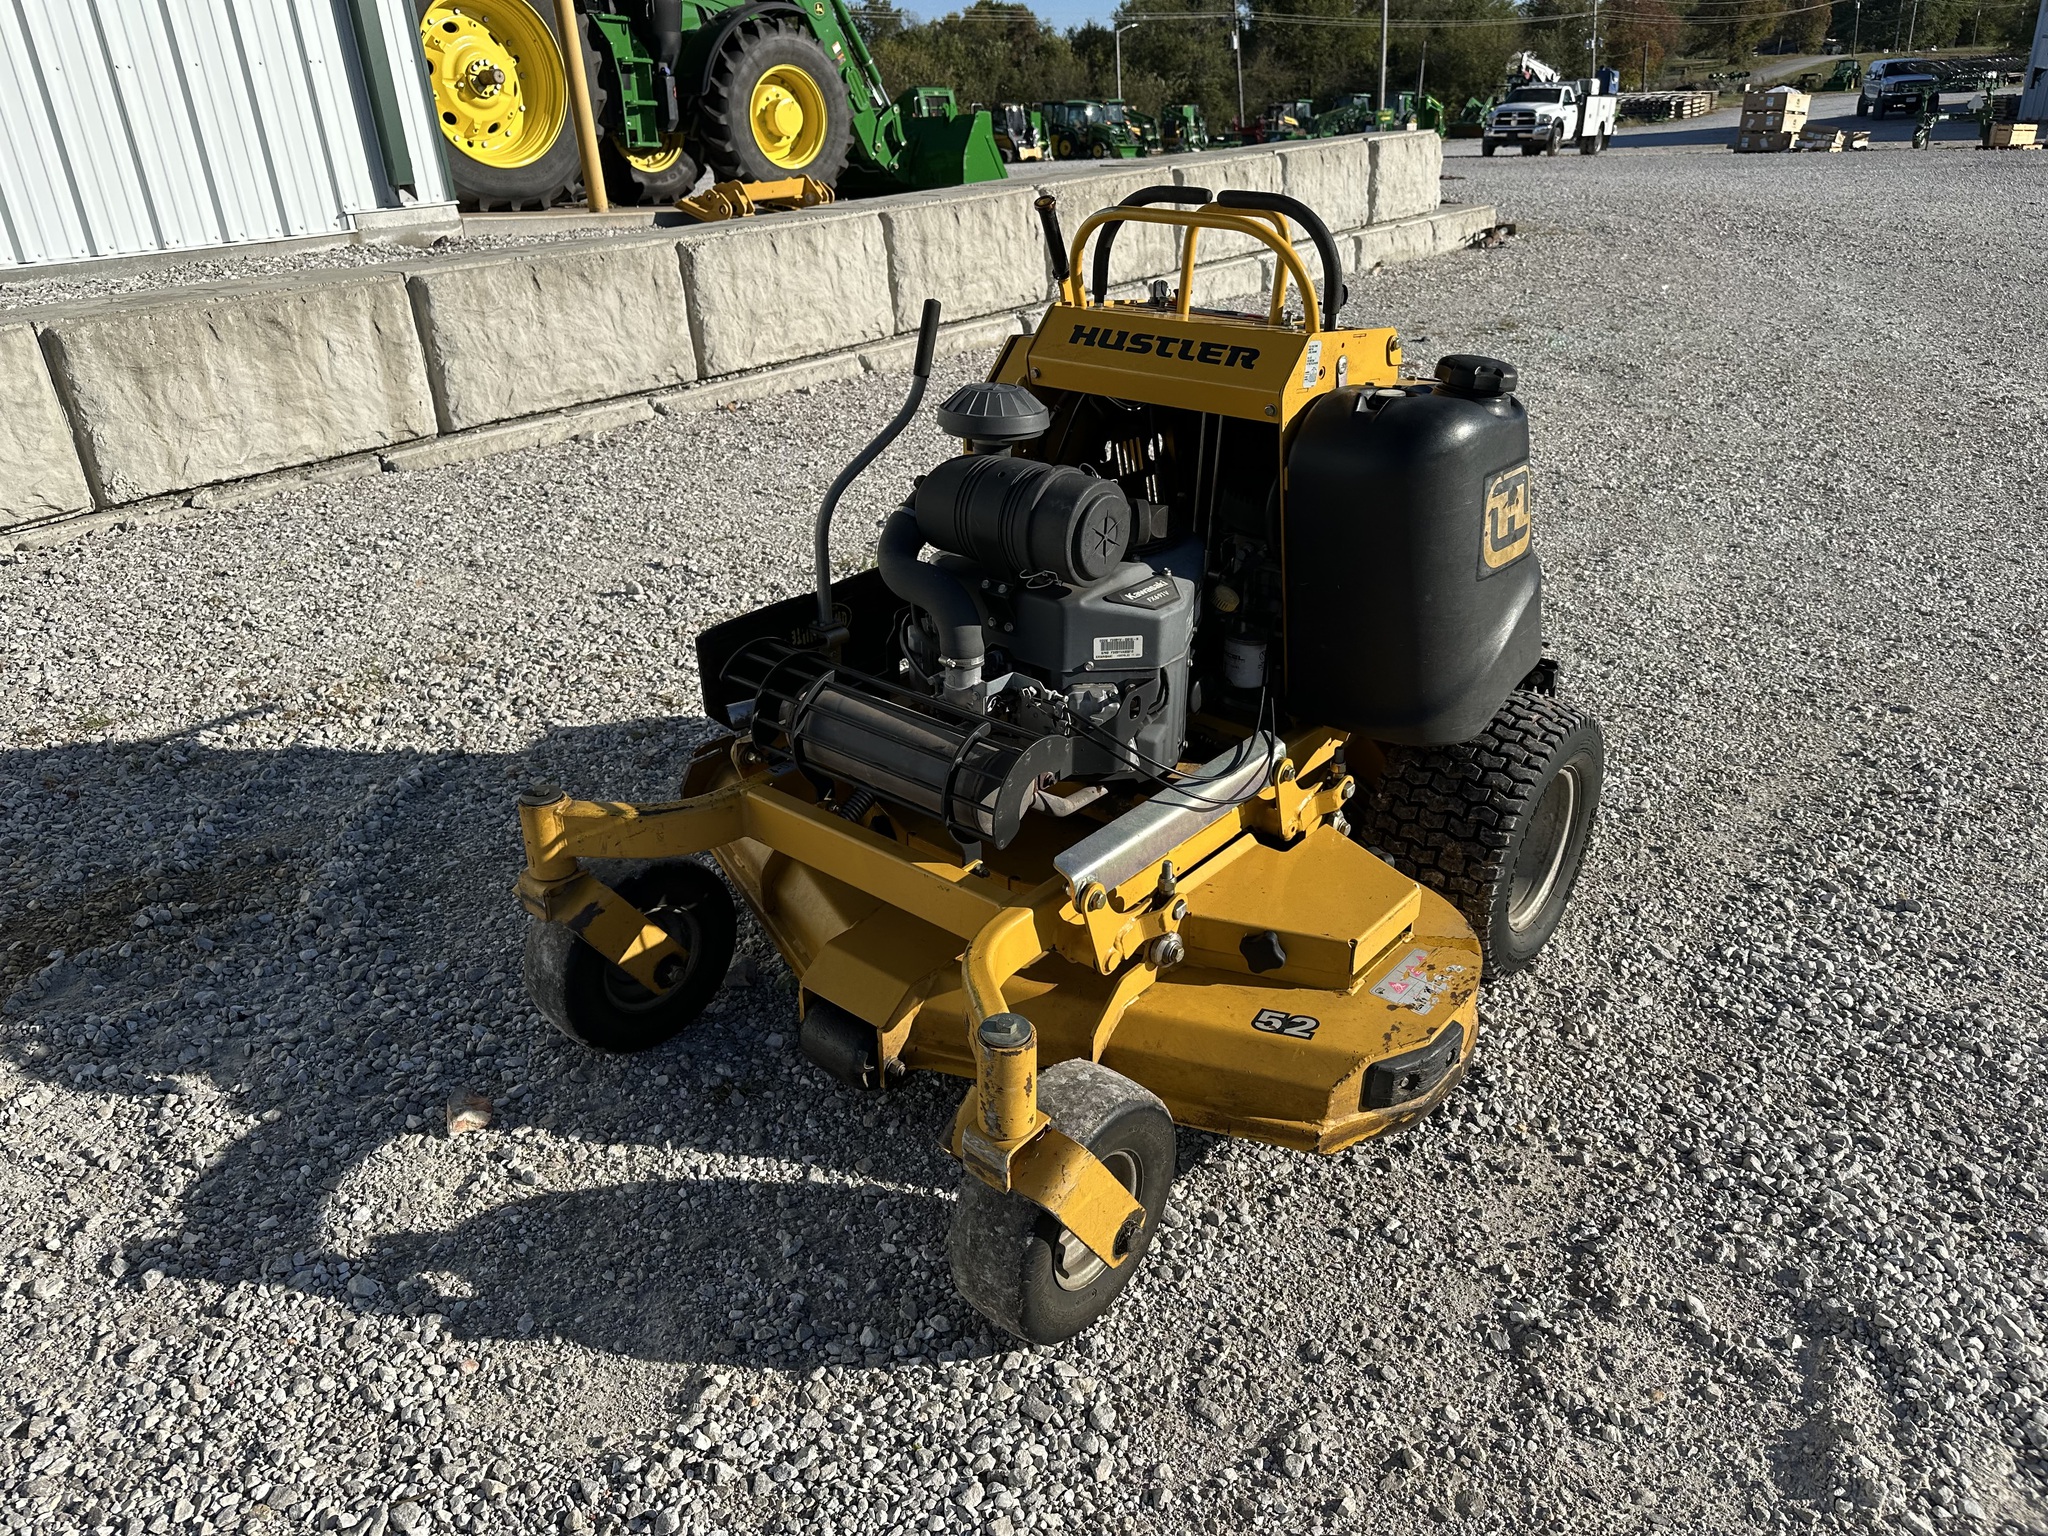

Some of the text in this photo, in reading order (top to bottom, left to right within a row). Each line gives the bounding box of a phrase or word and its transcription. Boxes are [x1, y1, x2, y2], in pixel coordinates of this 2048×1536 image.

[1068, 325, 1260, 370] HUSTLER
[1124, 580, 1169, 600] Kawasaki
[1252, 1008, 1319, 1040] 52
